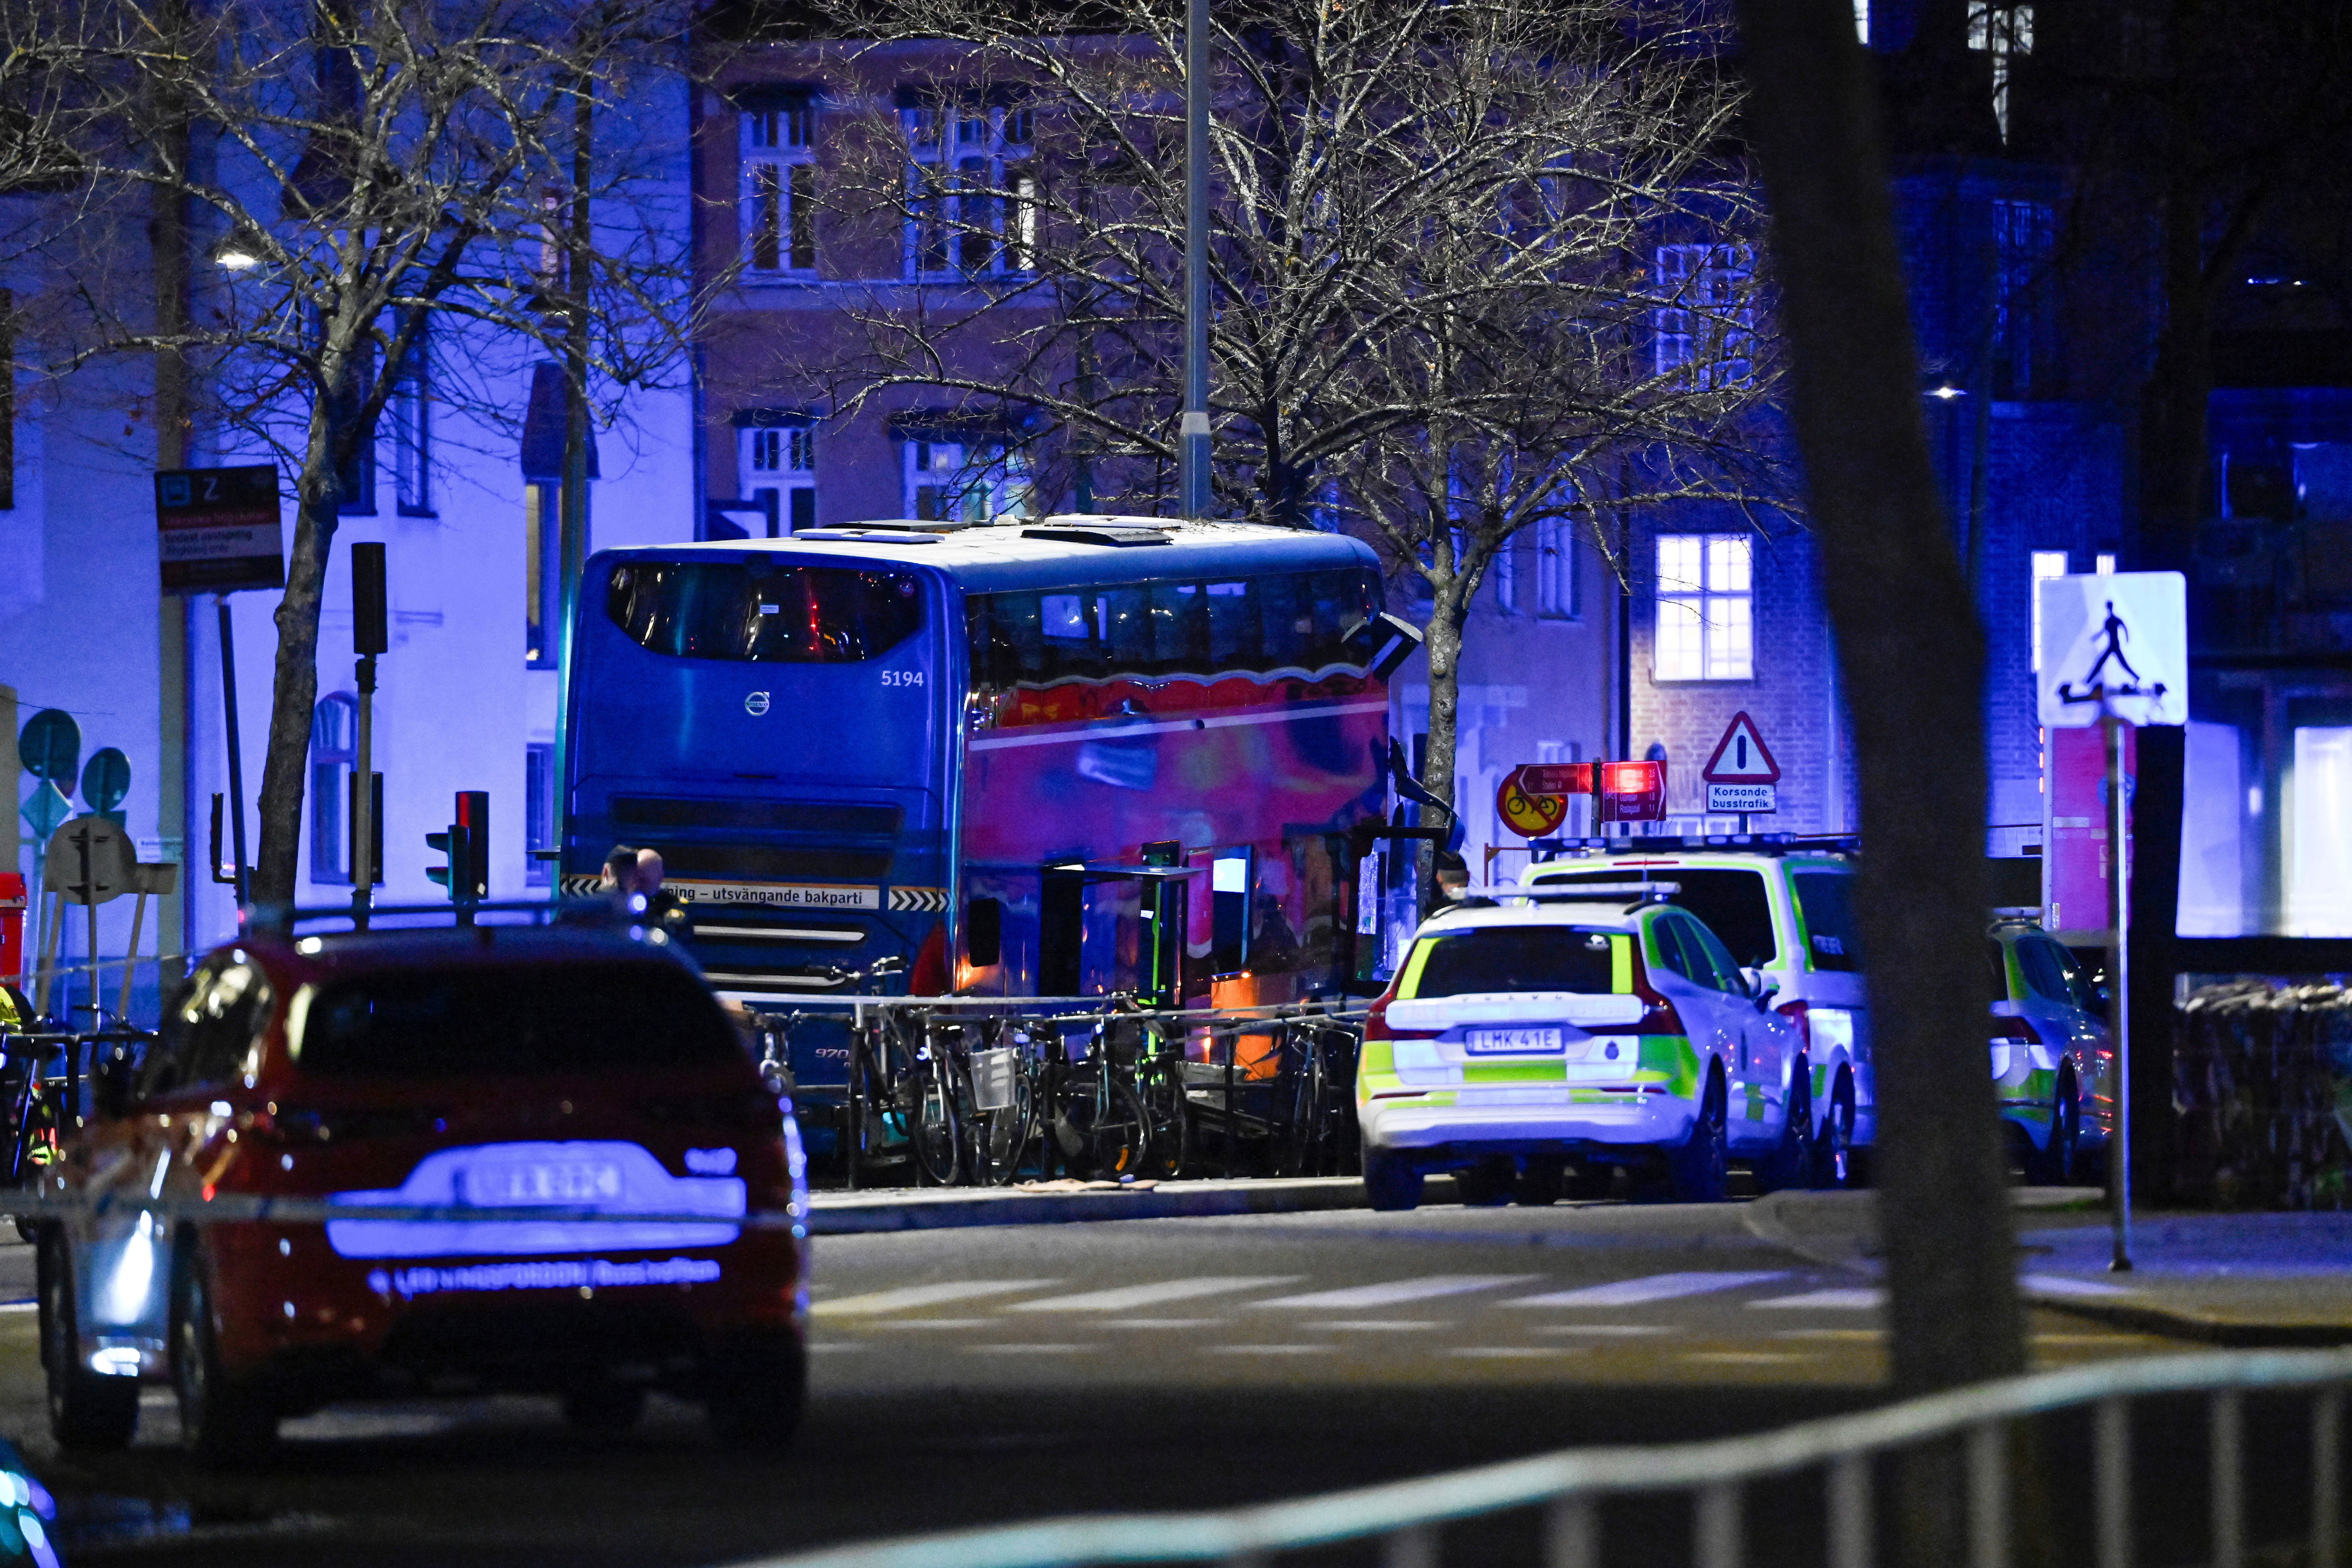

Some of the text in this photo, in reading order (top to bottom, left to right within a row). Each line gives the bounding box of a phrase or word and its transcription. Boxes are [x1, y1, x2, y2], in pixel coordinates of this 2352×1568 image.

[203, 477, 220, 501] Z
[881, 670, 924, 687] 5194
[1715, 787, 1768, 796] Korsande
[1713, 799, 1769, 808] busstrafik
[713, 887, 800, 904] utsvängande
[805, 890, 862, 906] bakparti
[1480, 1029, 1553, 1048] LMK 41E
